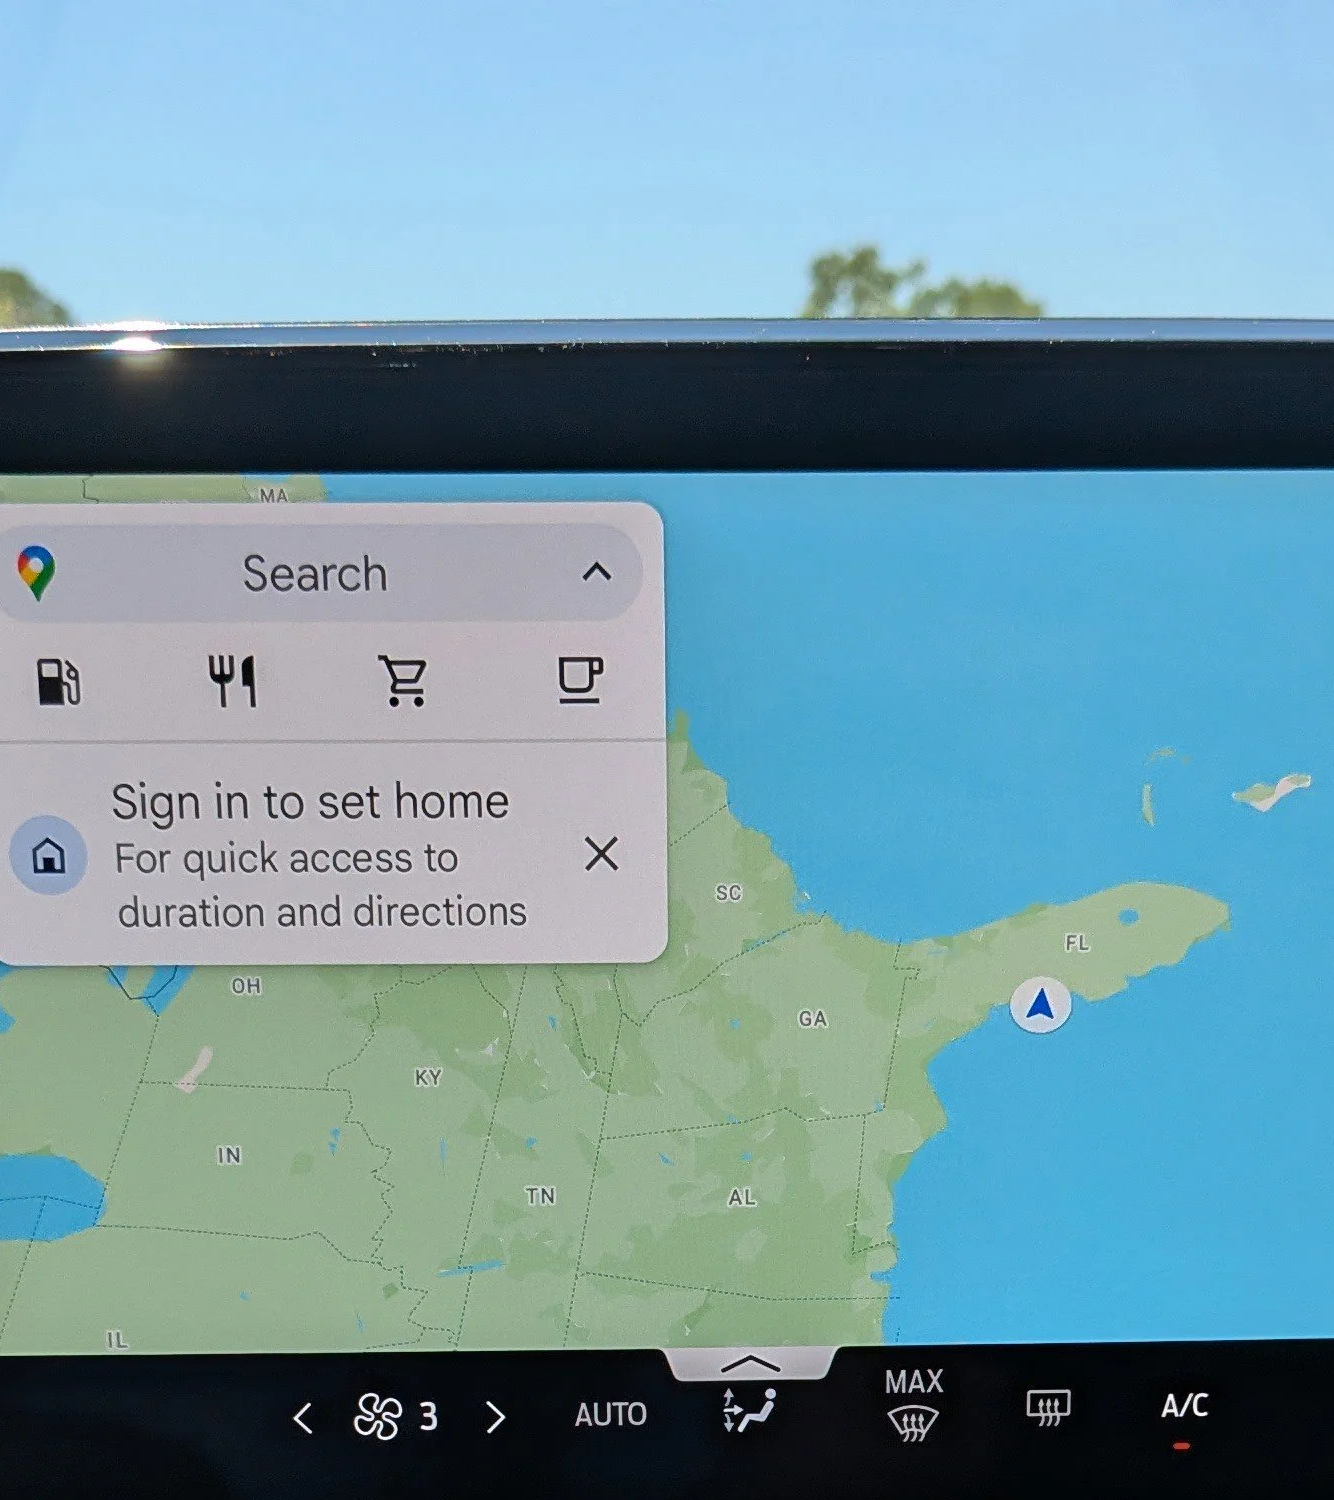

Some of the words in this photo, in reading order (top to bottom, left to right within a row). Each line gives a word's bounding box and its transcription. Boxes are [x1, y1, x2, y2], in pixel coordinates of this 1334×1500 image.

[260, 488, 288, 503] MA
[243, 553, 388, 593] Search
[112, 782, 200, 829] Sign
[215, 782, 249, 820] in
[264, 788, 305, 819] to
[318, 788, 381, 819] set
[396, 781, 510, 819] home
[115, 842, 167, 874] For
[183, 840, 278, 881] quick
[290, 847, 412, 873] access
[426, 844, 459, 873] to
[715, 884, 742, 902] SC
[118, 896, 265, 929] duration
[277, 896, 342, 928] and
[353, 895, 528, 928] directions
[1065, 934, 1090, 953] FL
[231, 977, 261, 996] OH
[798, 1009, 827, 1028] GA
[414, 1068, 442, 1088] KY
[217, 1146, 242, 1166] IN
[526, 1186, 556, 1206] TN
[727, 1188, 756, 1207] AL
[106, 1331, 129, 1351] IL
[885, 1368, 944, 1395] MAX
[574, 1401, 648, 1428] AUTO
[1161, 1391, 1209, 1418] A/C
[419, 1402, 439, 1431] 3
